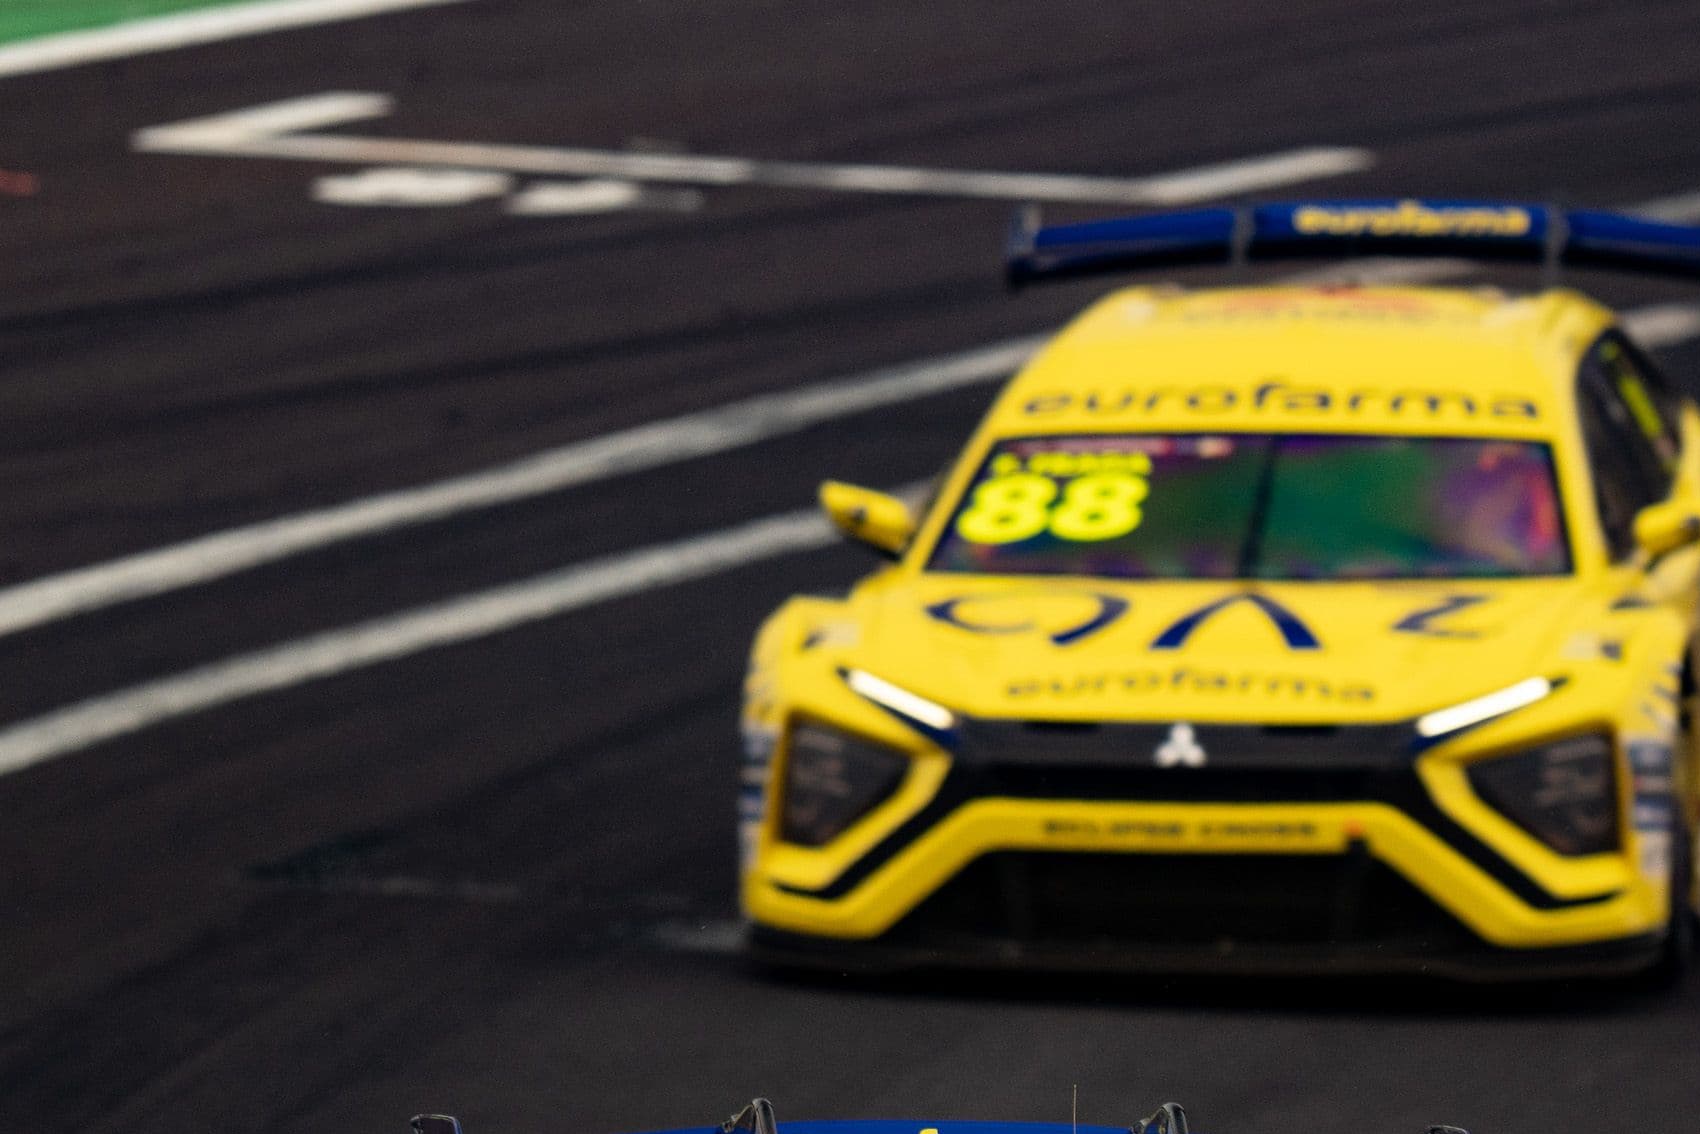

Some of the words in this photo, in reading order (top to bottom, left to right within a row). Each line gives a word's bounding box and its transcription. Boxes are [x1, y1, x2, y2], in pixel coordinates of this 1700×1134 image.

[1294, 201, 1530, 235] eurofarma
[1020, 377, 1540, 421] eurofarma
[957, 473, 1147, 544] 88
[1003, 667, 1377, 703] eurofarma
